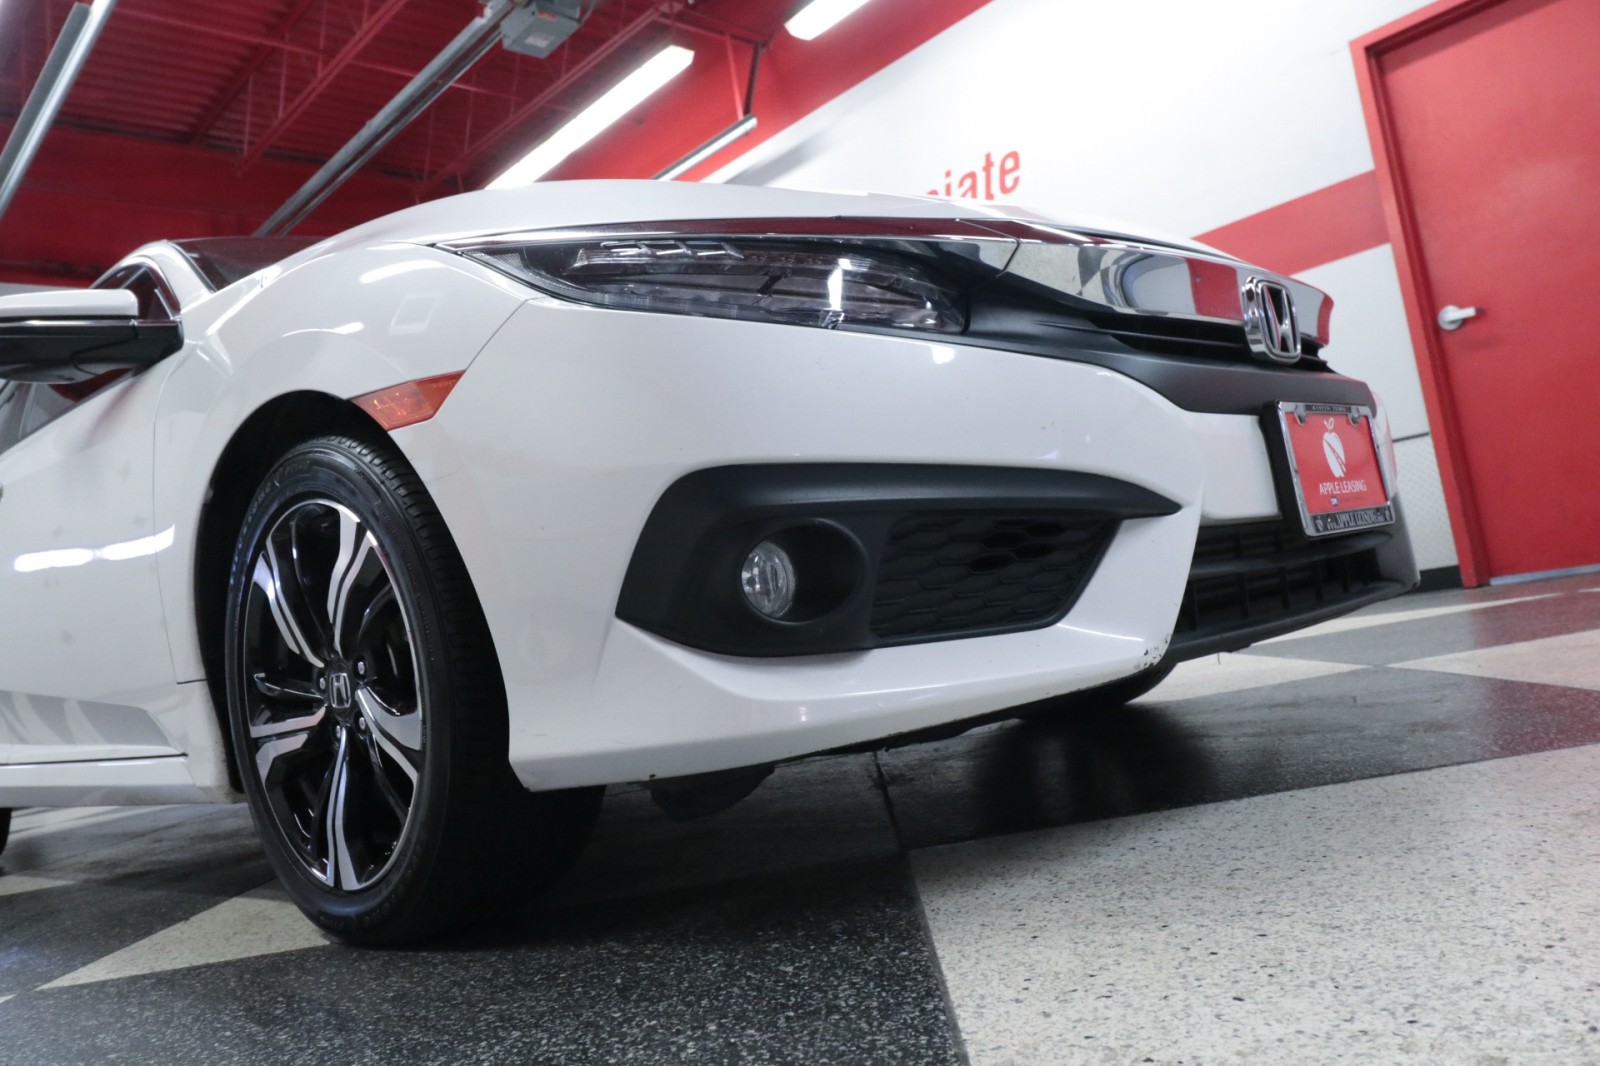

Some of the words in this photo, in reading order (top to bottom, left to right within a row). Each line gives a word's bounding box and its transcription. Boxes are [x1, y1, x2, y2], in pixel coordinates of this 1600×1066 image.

[926, 150, 1020, 200] iate
[1319, 481, 1340, 496] APPLE
[1340, 479, 1367, 494] LEASING
